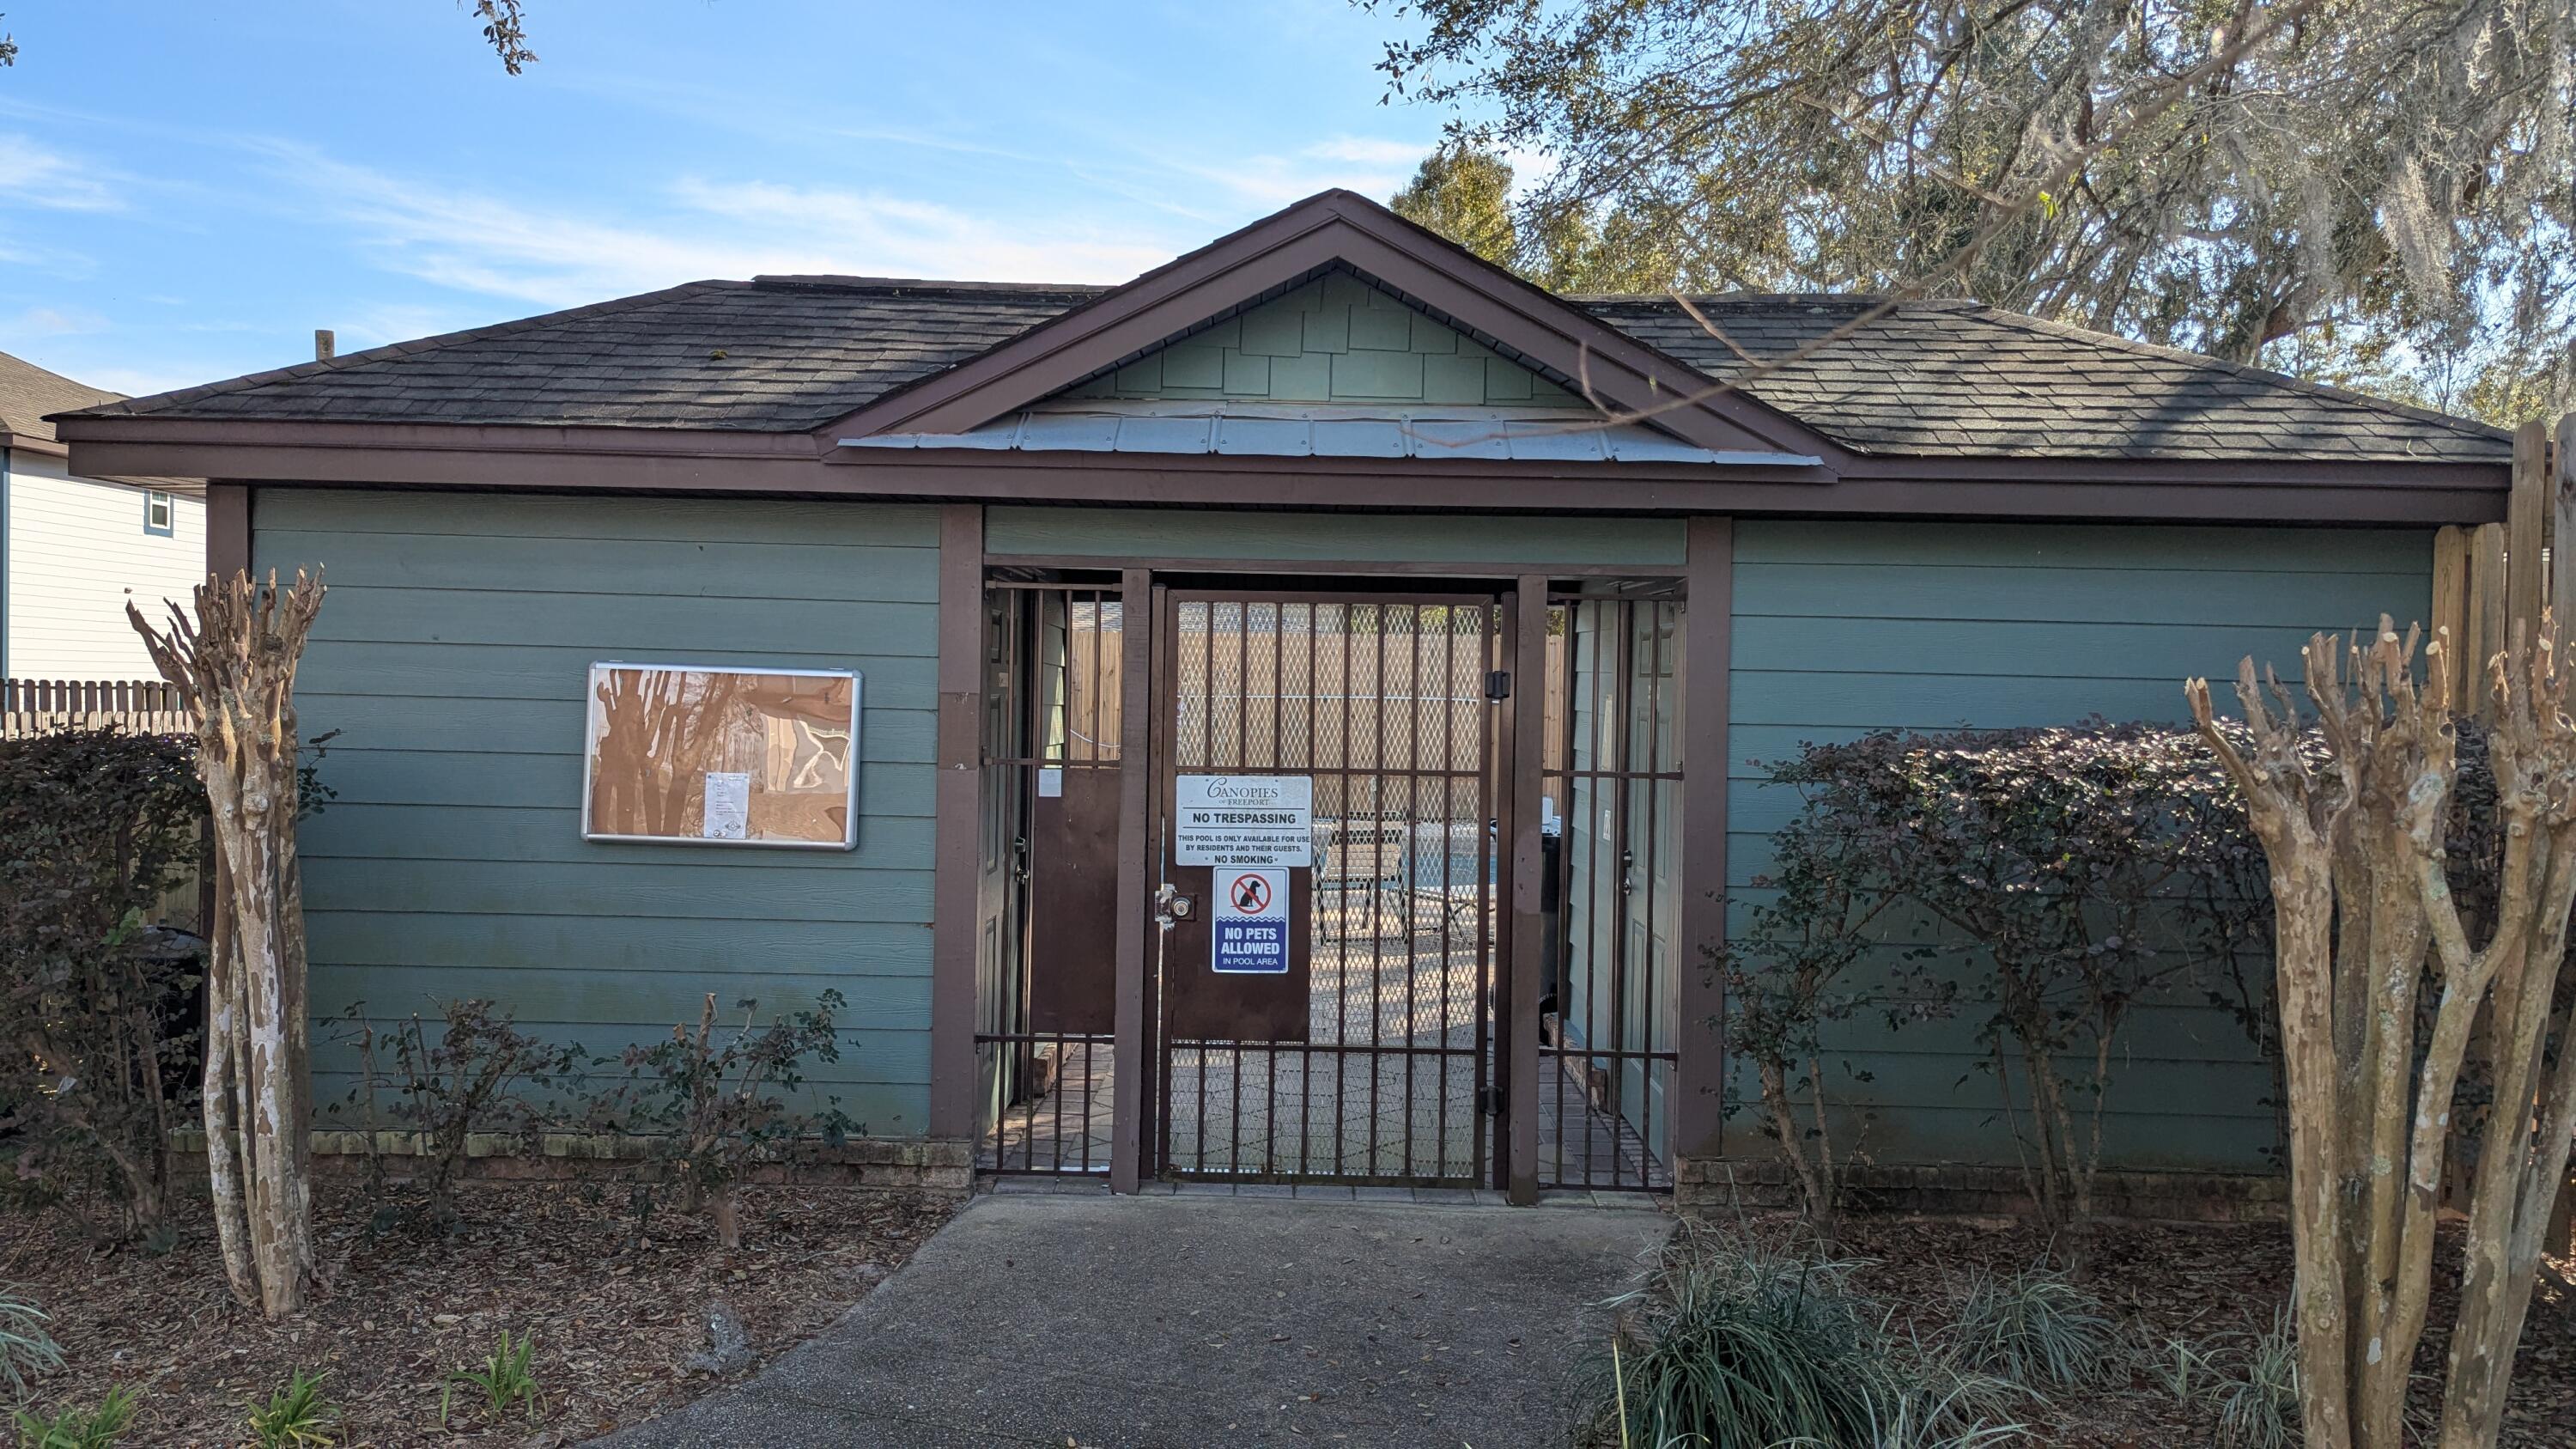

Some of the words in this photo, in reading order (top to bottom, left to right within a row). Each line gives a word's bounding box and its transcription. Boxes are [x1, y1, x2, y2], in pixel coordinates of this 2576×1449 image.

[1207, 777, 1279, 798] CANOPIES
[1193, 813, 1210, 823] NO
[1213, 813, 1297, 825] TRESPASSING
[1214, 855, 1228, 864] NO
[1230, 855, 1273, 864] SMOKING
[1224, 928, 1242, 940] NO
[1246, 928, 1278, 941] PETS
[1221, 942, 1280, 955] ALLOWED
